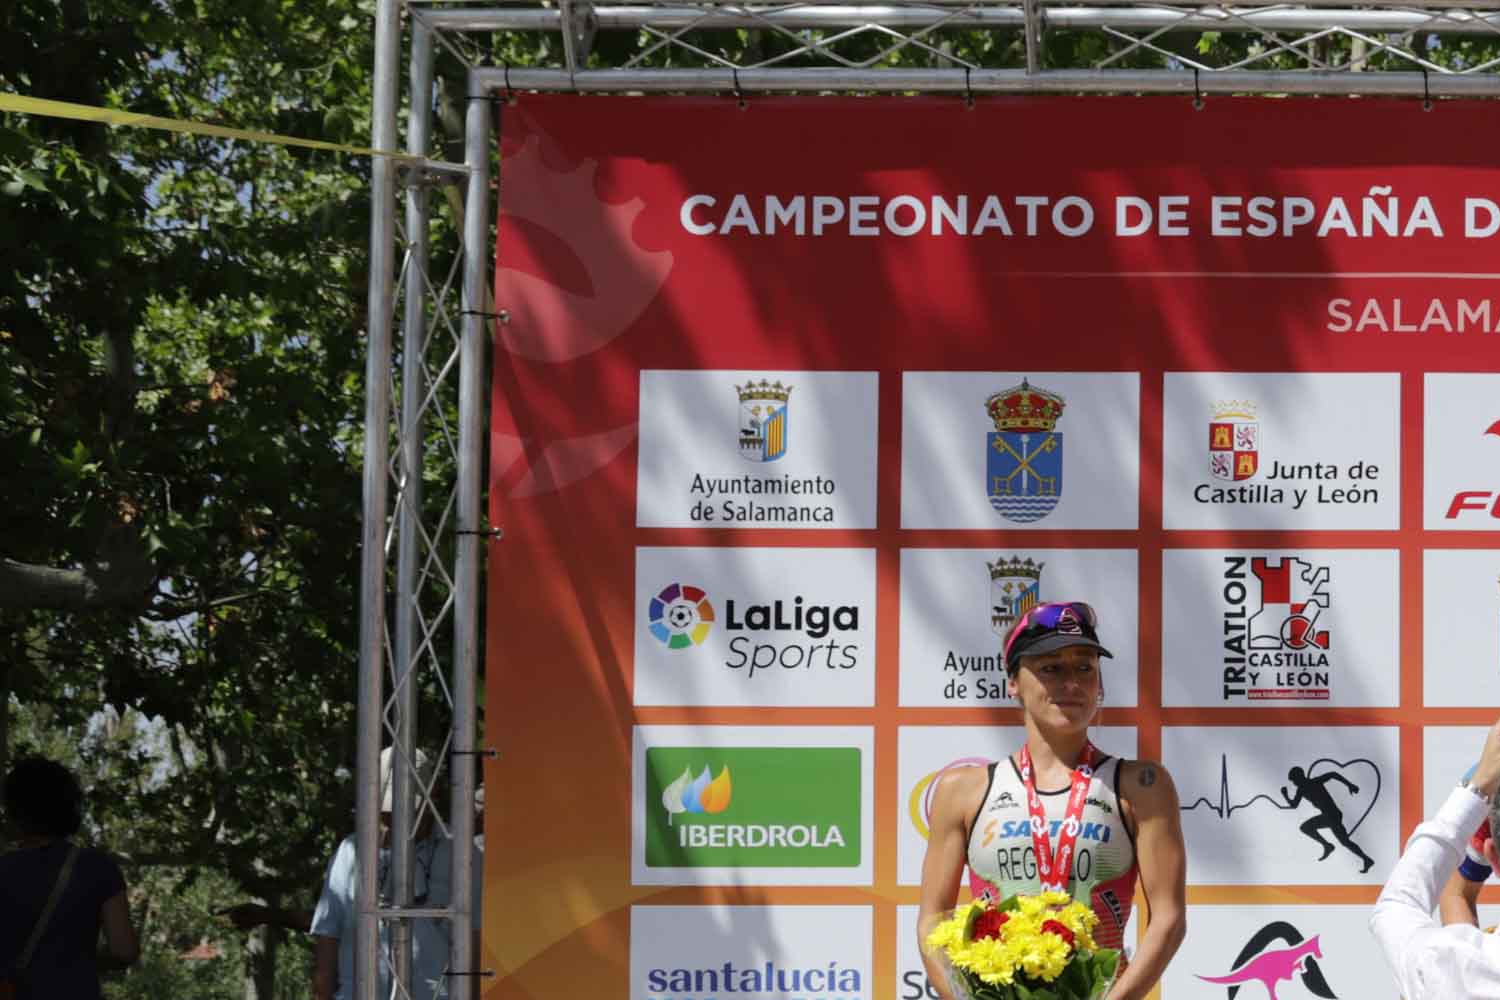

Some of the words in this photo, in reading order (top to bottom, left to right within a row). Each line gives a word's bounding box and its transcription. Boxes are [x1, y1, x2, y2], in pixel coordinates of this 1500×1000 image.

[680, 194, 1094, 237] CAMPEONATO
[1116, 195, 1190, 237] DE
[1211, 185, 1444, 239] ESPAÑA
[1266, 460, 1339, 480] Junta
[1347, 460, 1380, 480] de
[690, 473, 836, 499] Ayuntamiento
[1193, 481, 1286, 504] Castilla
[1292, 489, 1308, 510] y
[1316, 482, 1379, 504] León
[690, 501, 715, 522] de
[721, 501, 835, 523] Salamanca
[726, 596, 859, 638] LaLiga
[1223, 556, 1247, 701] TRIATLON
[725, 637, 859, 677] Sports
[1248, 652, 1329, 668] CASTILLA
[943, 678, 968, 700] de
[1248, 672, 1260, 687] Y
[1276, 668, 1329, 687] LEÓN
[678, 823, 847, 849] IBERDROLA
[647, 961, 861, 993] santalucía
